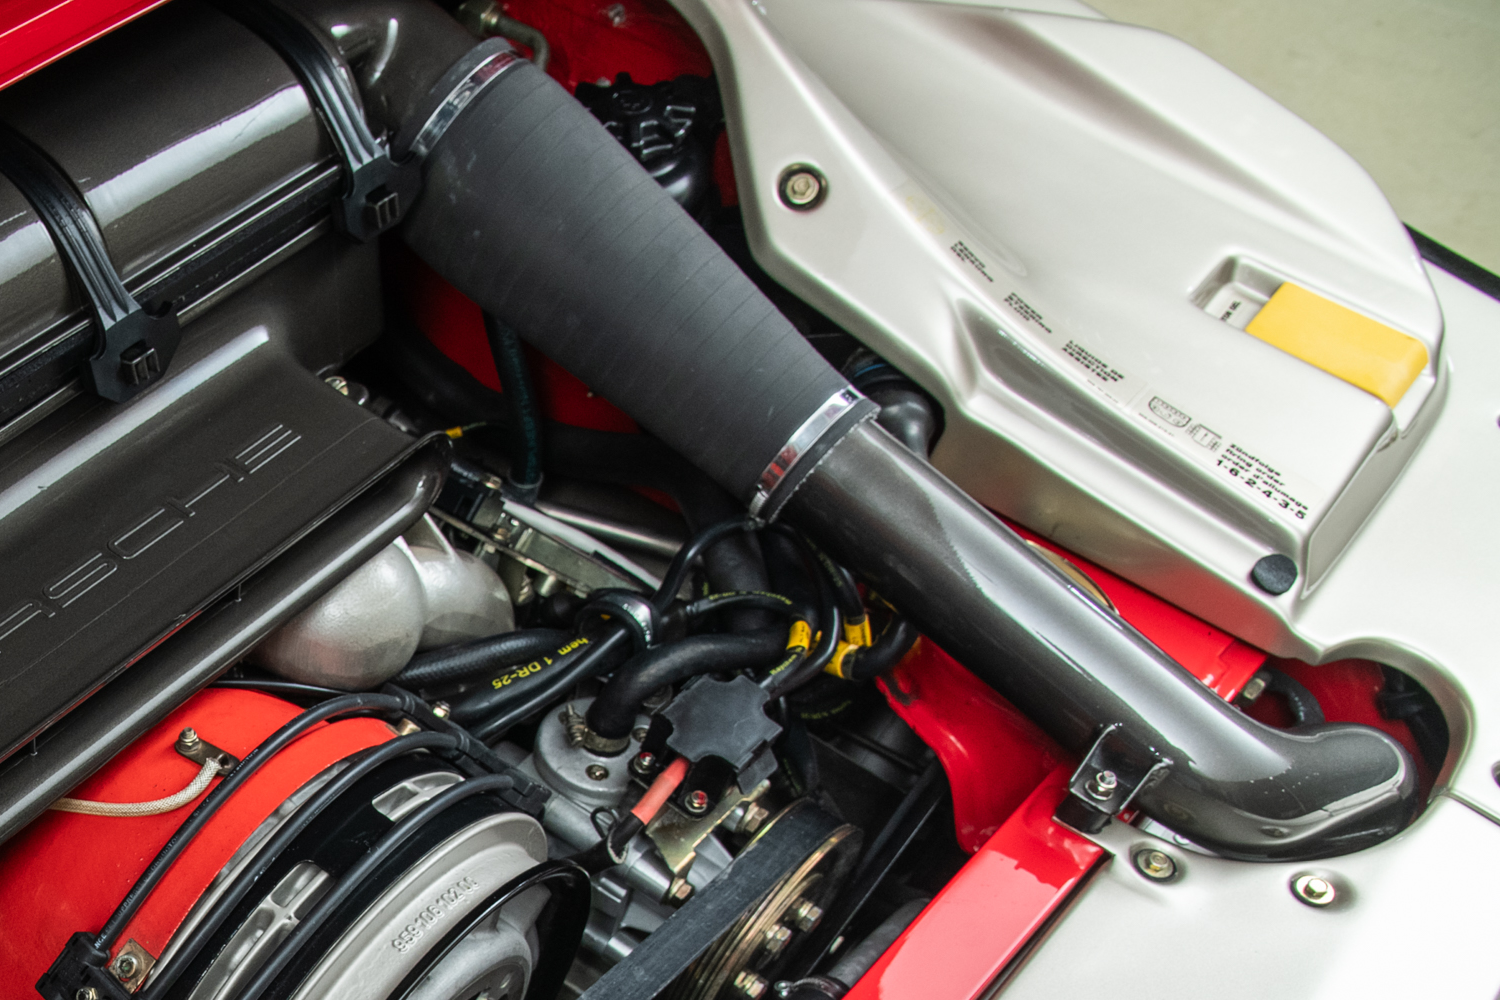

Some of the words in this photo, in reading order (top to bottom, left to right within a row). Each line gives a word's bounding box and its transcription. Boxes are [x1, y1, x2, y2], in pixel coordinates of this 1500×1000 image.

[1224, 447, 1253, 468] firing
[1254, 466, 1285, 488] order
[556, 632, 589, 660] hem
[489, 659, 542, 690] DR-25
